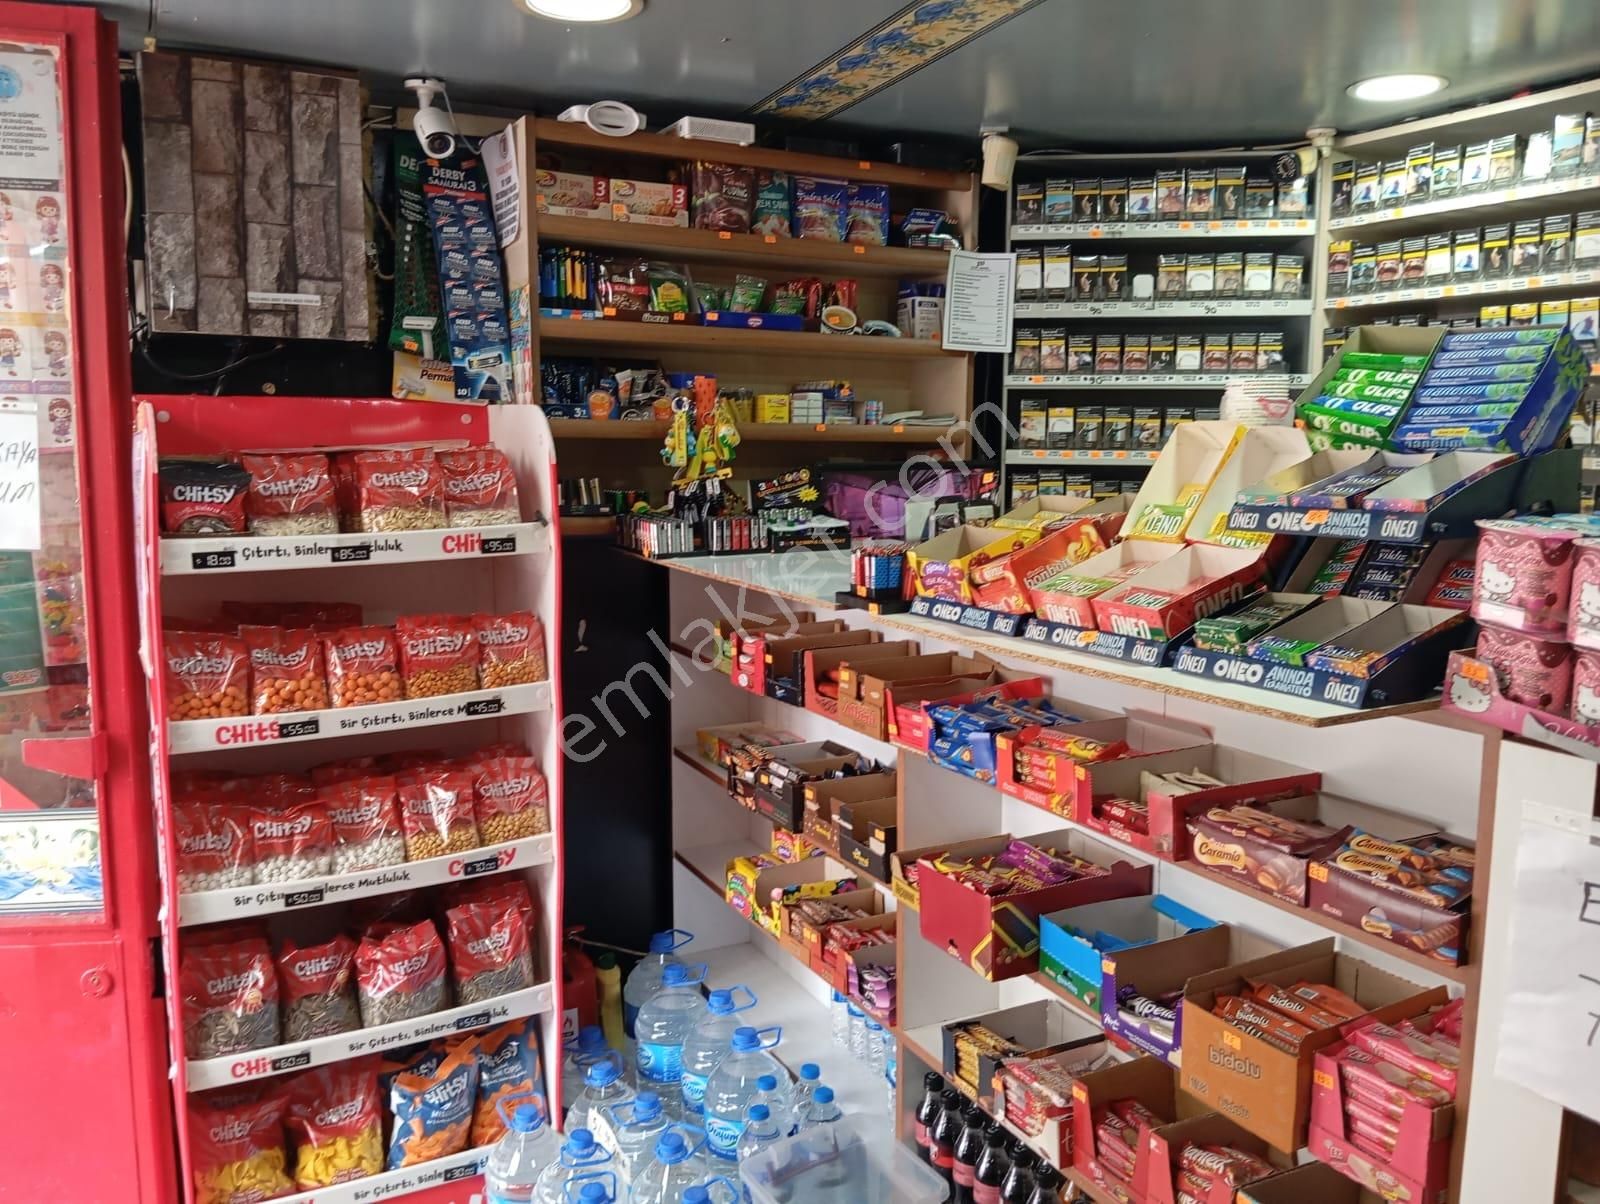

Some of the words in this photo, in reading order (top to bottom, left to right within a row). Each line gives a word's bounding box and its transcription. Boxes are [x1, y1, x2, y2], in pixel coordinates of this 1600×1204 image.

[432, 166, 466, 181] DERBY
[595, 181, 606, 196] 3
[675, 188, 685, 204] 3
[173, 485, 236, 504] CHitsy
[1230, 511, 1261, 529] ONEO
[1381, 520, 1417, 538] ONEO
[442, 532, 482, 554] CHit
[1025, 624, 1048, 641] ONEO
[1131, 644, 1158, 663] ONEO
[1178, 653, 1207, 674] ONEO
[1213, 658, 1264, 684] ONEO
[1266, 666, 1315, 690] ANINDA
[1324, 681, 1360, 705] ONEO
[340, 719, 358, 730] Bir
[361, 711, 406, 729] Çıtırtı,
[408, 705, 455, 722] Binlerce
[215, 719, 281, 745] CHits
[234, 896, 253, 907] Bir
[358, 870, 411, 888] Mutluluk
[1268, 993, 1305, 1013] bidolu
[1236, 1009, 1271, 1029] bidolu
[1209, 1045, 1262, 1079] bidolu
